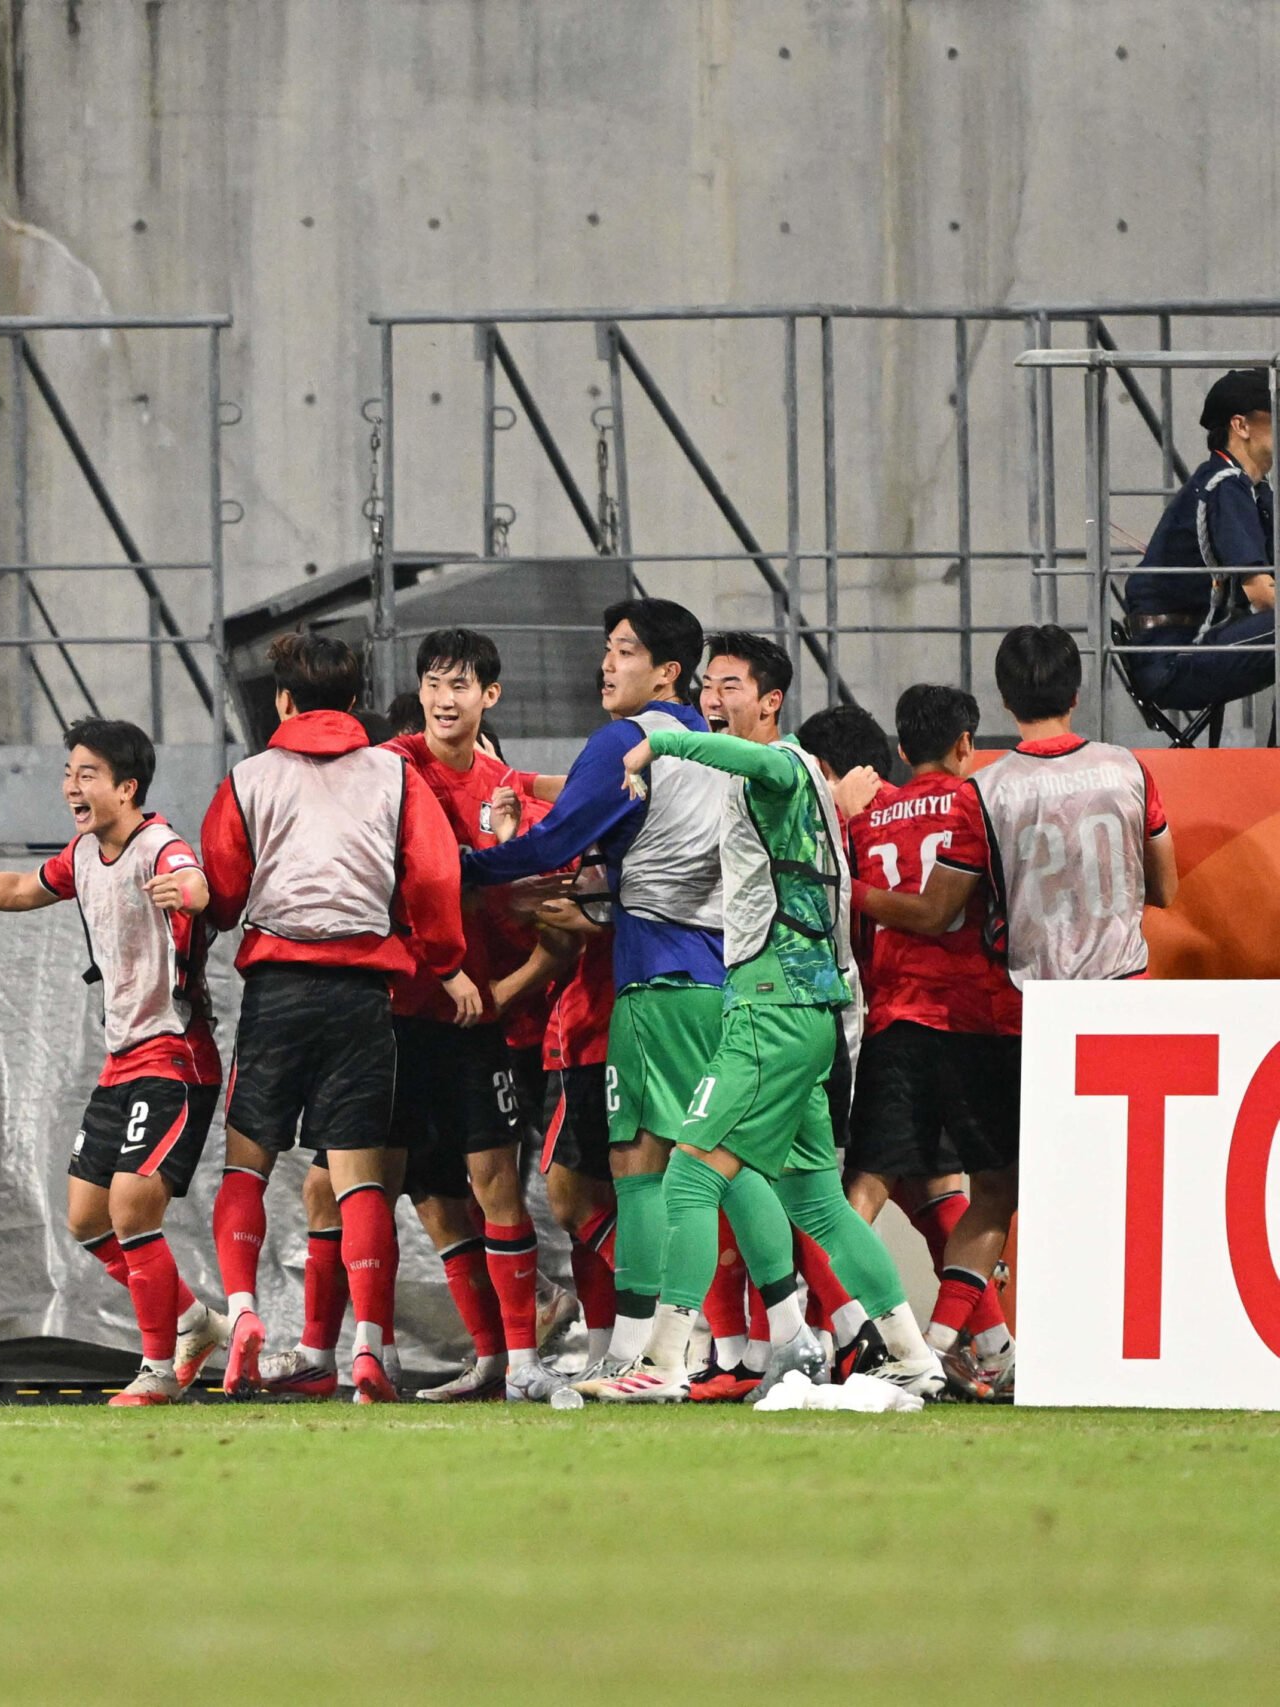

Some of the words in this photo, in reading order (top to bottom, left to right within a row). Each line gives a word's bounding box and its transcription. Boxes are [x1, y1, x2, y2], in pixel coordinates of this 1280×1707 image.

[870, 792, 957, 827] SEOKHYU
[1018, 813, 1127, 923] 20
[127, 1101, 149, 1142] 2
